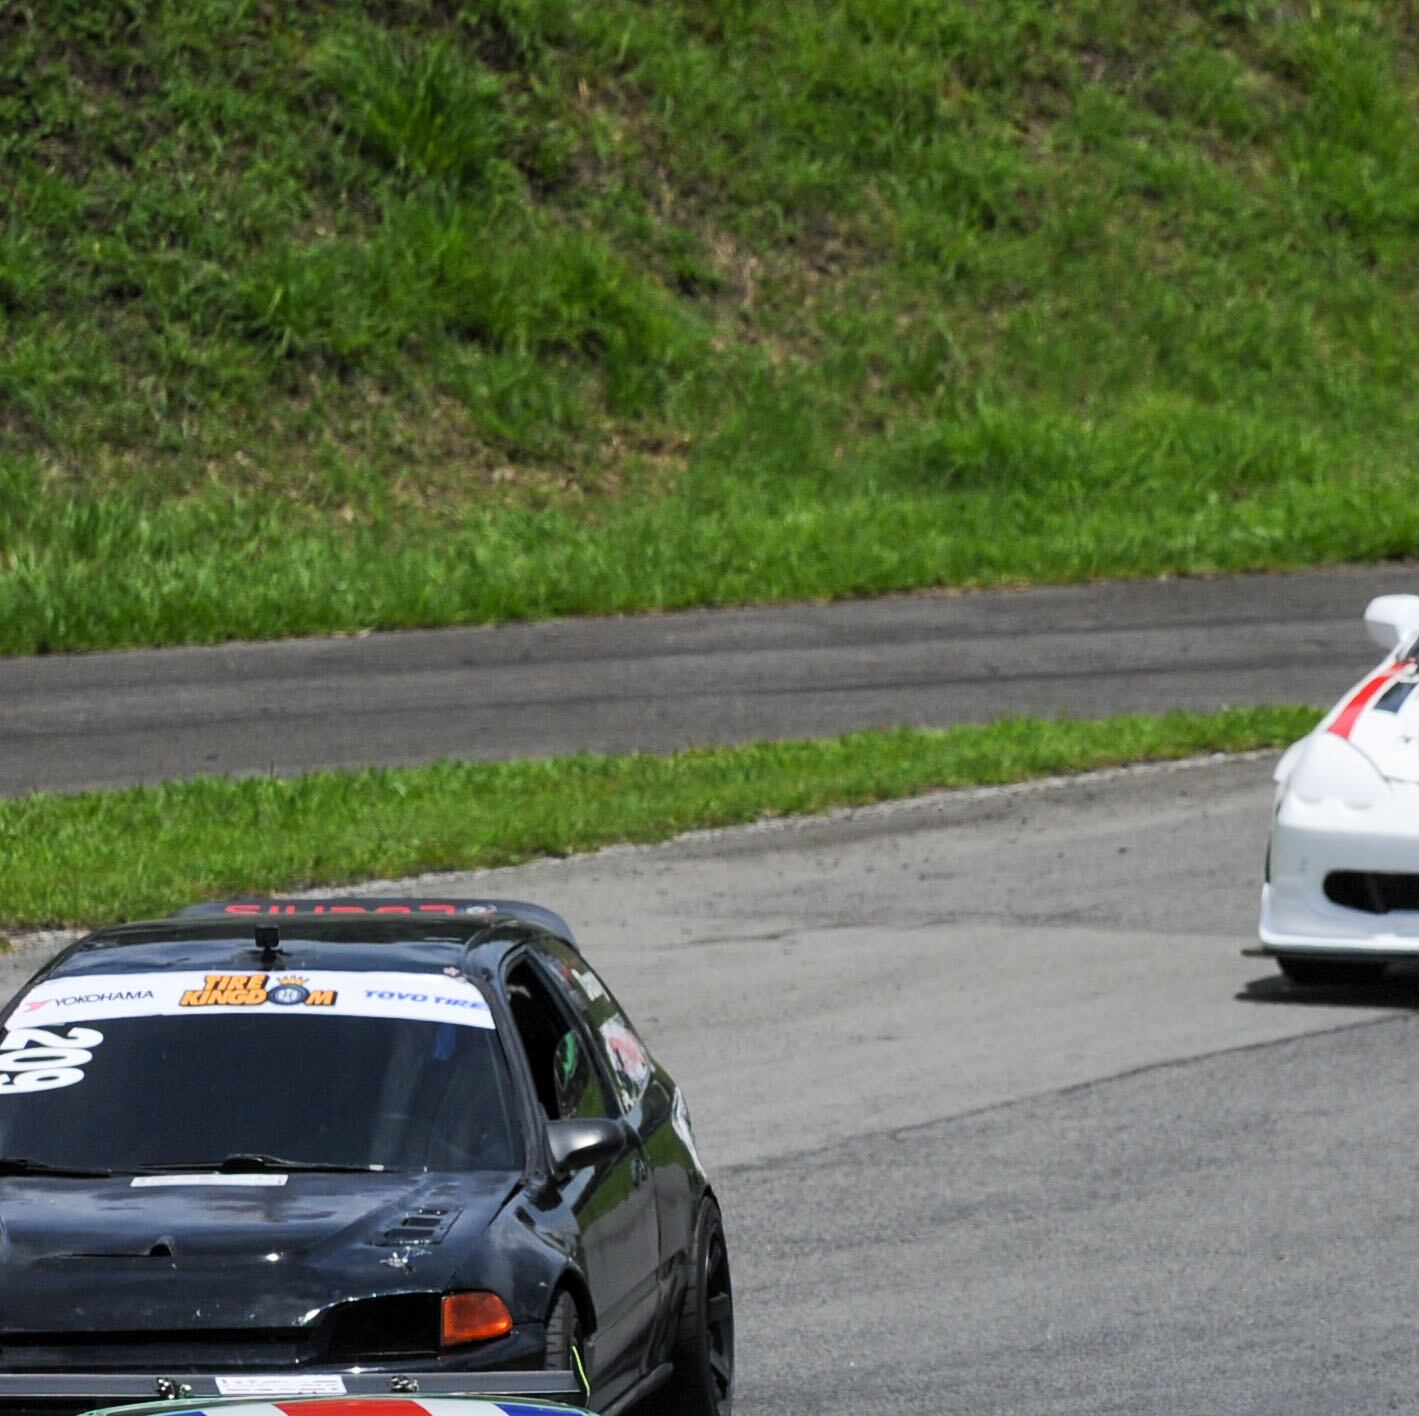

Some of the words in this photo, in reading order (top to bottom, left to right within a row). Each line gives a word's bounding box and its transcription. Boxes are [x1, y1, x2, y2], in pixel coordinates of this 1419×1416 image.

[204, 975, 269, 992] TIRE
[55, 990, 154, 1007] YOKOHAMA
[365, 990, 428, 1003] TOYO
